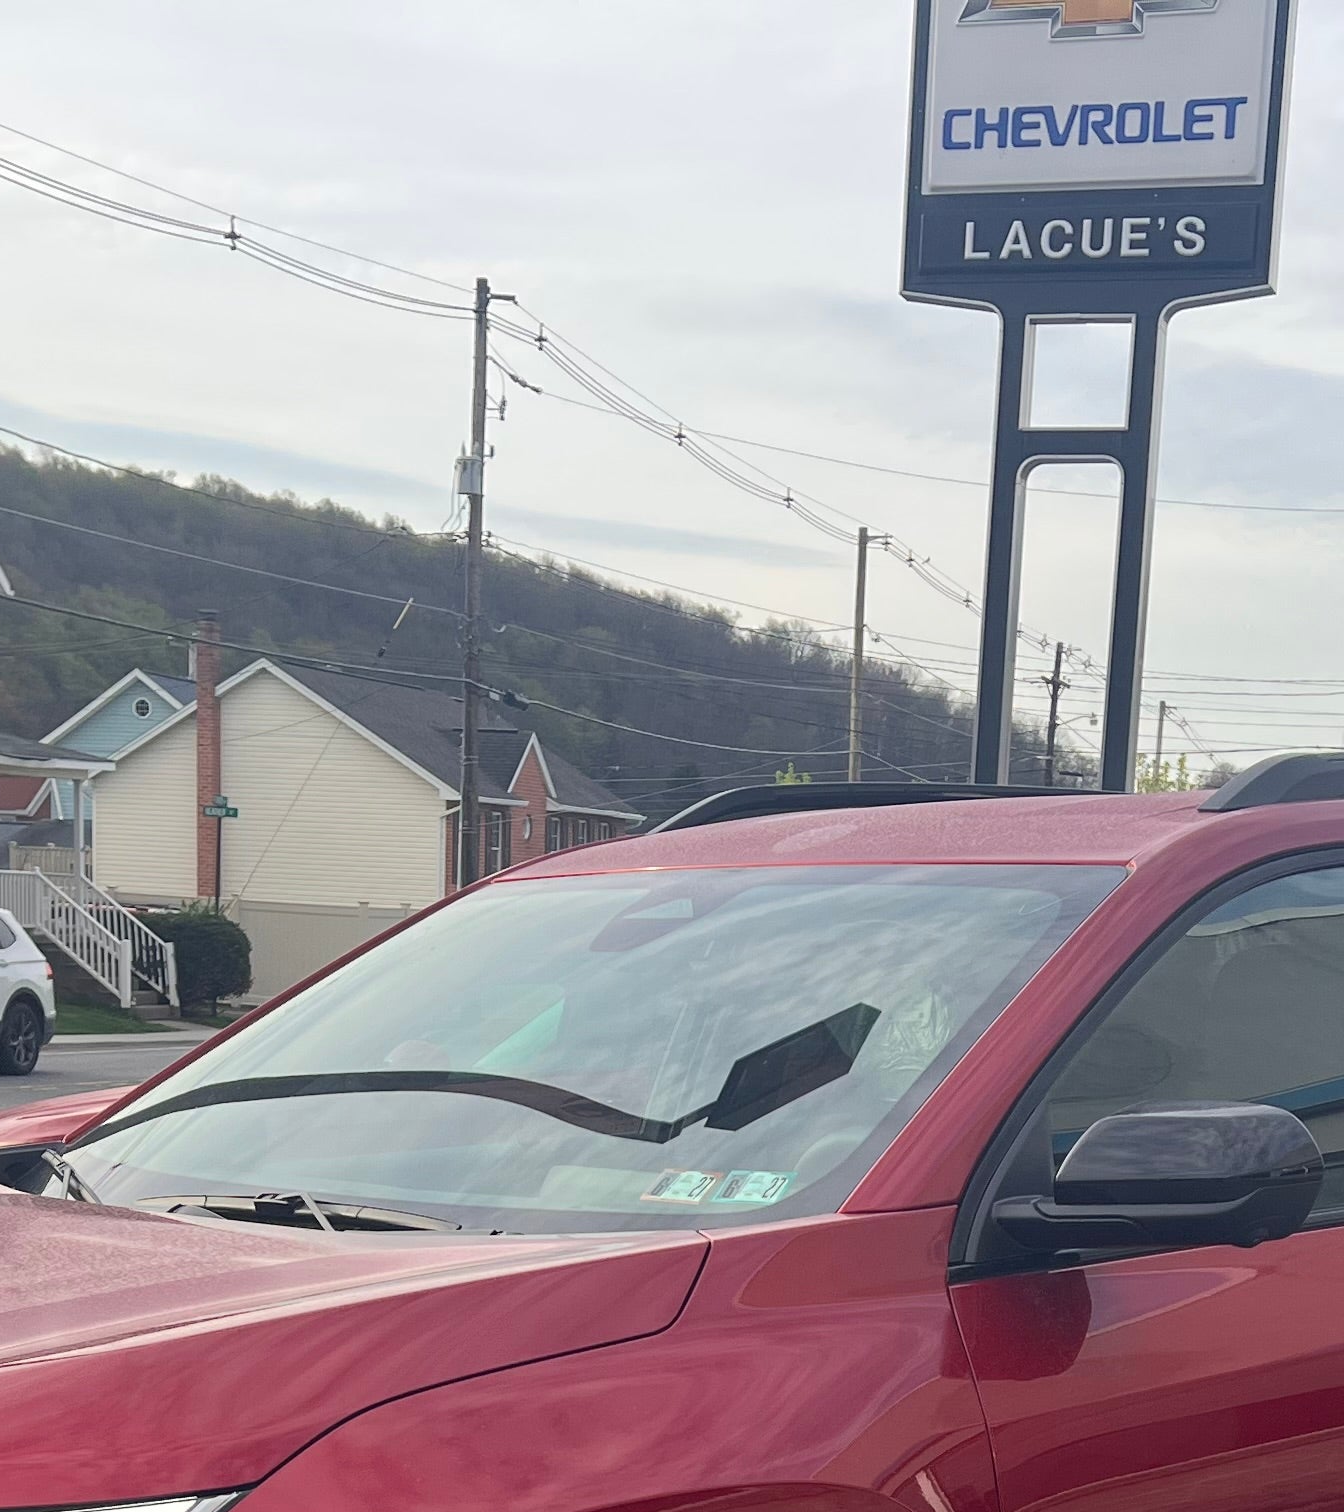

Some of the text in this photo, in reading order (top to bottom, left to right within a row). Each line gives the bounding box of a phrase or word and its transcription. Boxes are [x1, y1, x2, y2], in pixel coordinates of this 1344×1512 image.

[942, 96, 1248, 150] CHEVROLET
[963, 216, 1207, 260] LACUE'S
[687, 1176, 716, 1199] 27
[761, 1176, 788, 1199] 27
